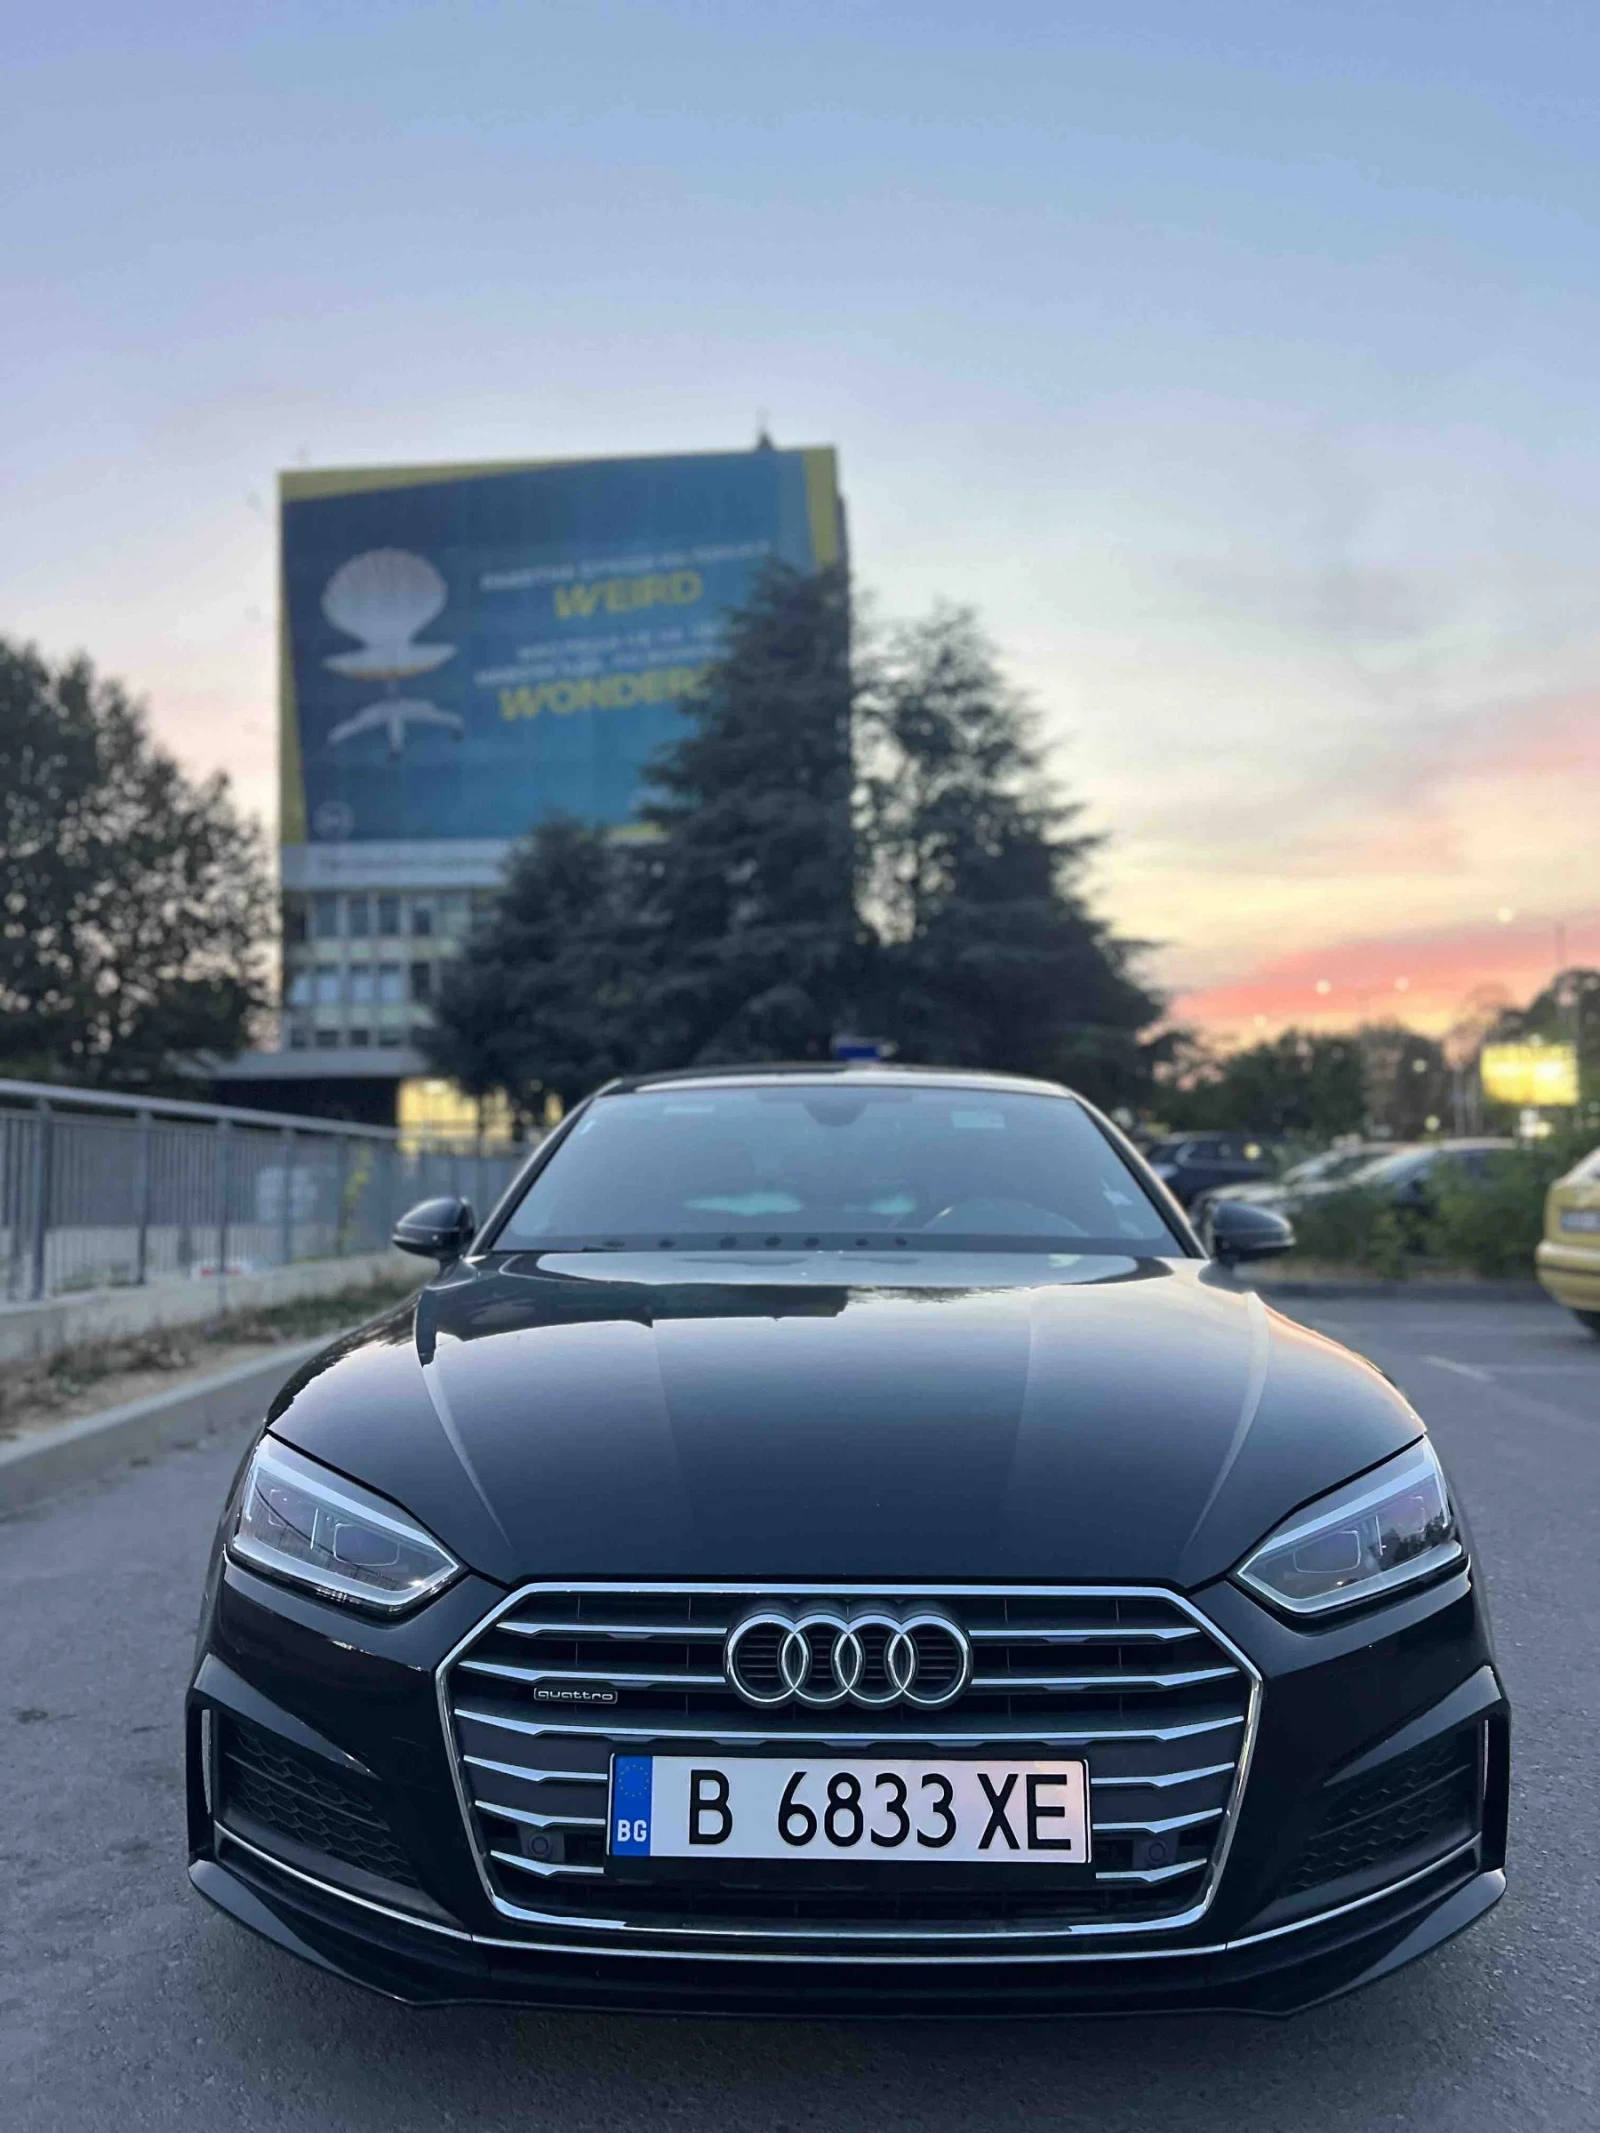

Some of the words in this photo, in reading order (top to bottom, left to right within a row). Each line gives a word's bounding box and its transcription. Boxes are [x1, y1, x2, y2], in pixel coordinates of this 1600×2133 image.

[555, 570, 703, 619] WEIRD
[499, 665, 716, 721] WONDER
[538, 1690, 614, 1701] quattro
[617, 1820, 647, 1842] BG
[688, 1769, 733, 1845] B
[777, 1771, 957, 1848] 6833
[977, 1773, 1072, 1850] XE
